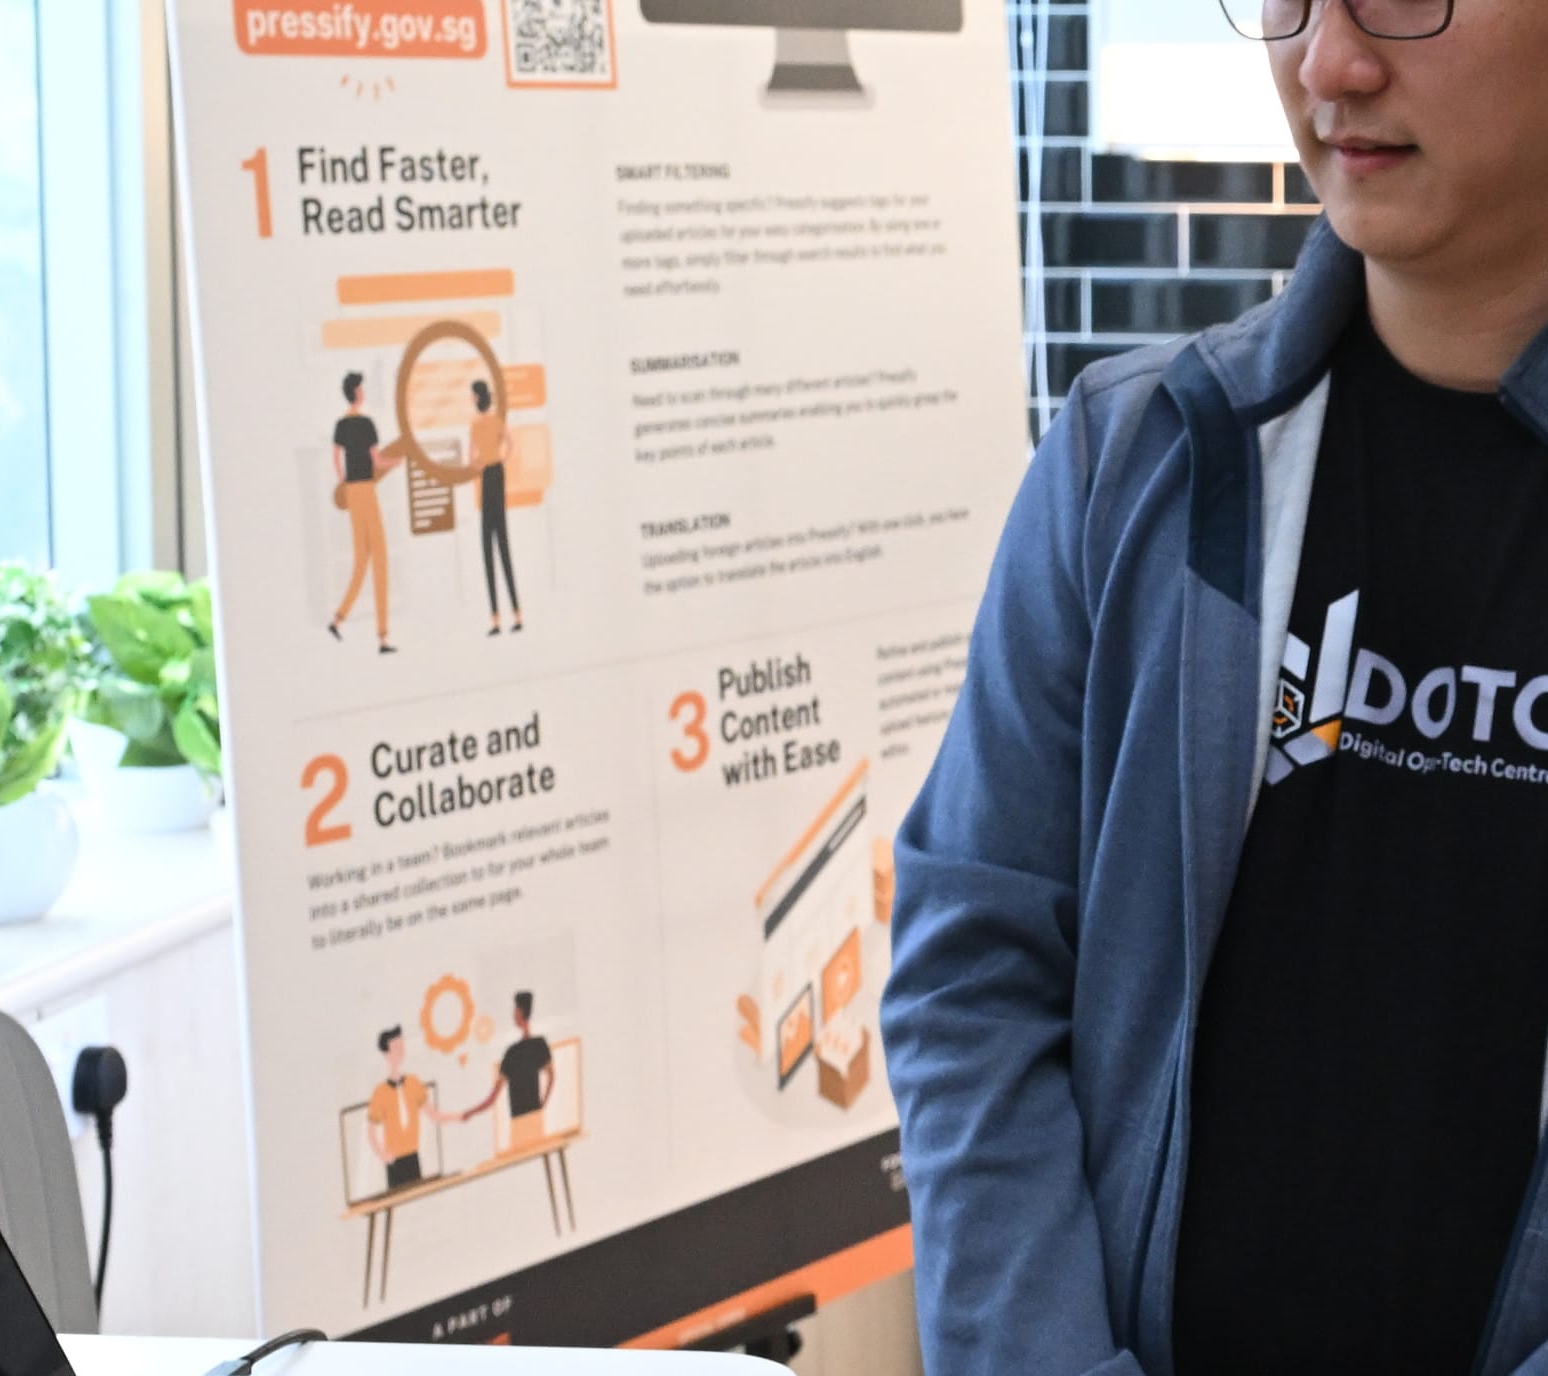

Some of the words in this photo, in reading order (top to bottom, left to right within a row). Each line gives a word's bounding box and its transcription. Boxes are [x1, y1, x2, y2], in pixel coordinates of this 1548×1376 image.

[246, 4, 478, 52] pressify.gov.sg
[298, 147, 369, 183] Find
[379, 147, 488, 181] Faster,
[240, 146, 274, 239] 1
[302, 198, 385, 233] Read
[395, 197, 521, 230] Smarter
[718, 653, 811, 697] Publish
[668, 688, 711, 773] 3
[720, 698, 820, 742] Content
[371, 731, 478, 778] Curate
[487, 712, 540, 755] and
[723, 746, 777, 785] with
[784, 741, 841, 772] Ease
[1339, 731, 1405, 768] Digital
[299, 751, 354, 849] 2
[374, 767, 555, 826] Collaborate
